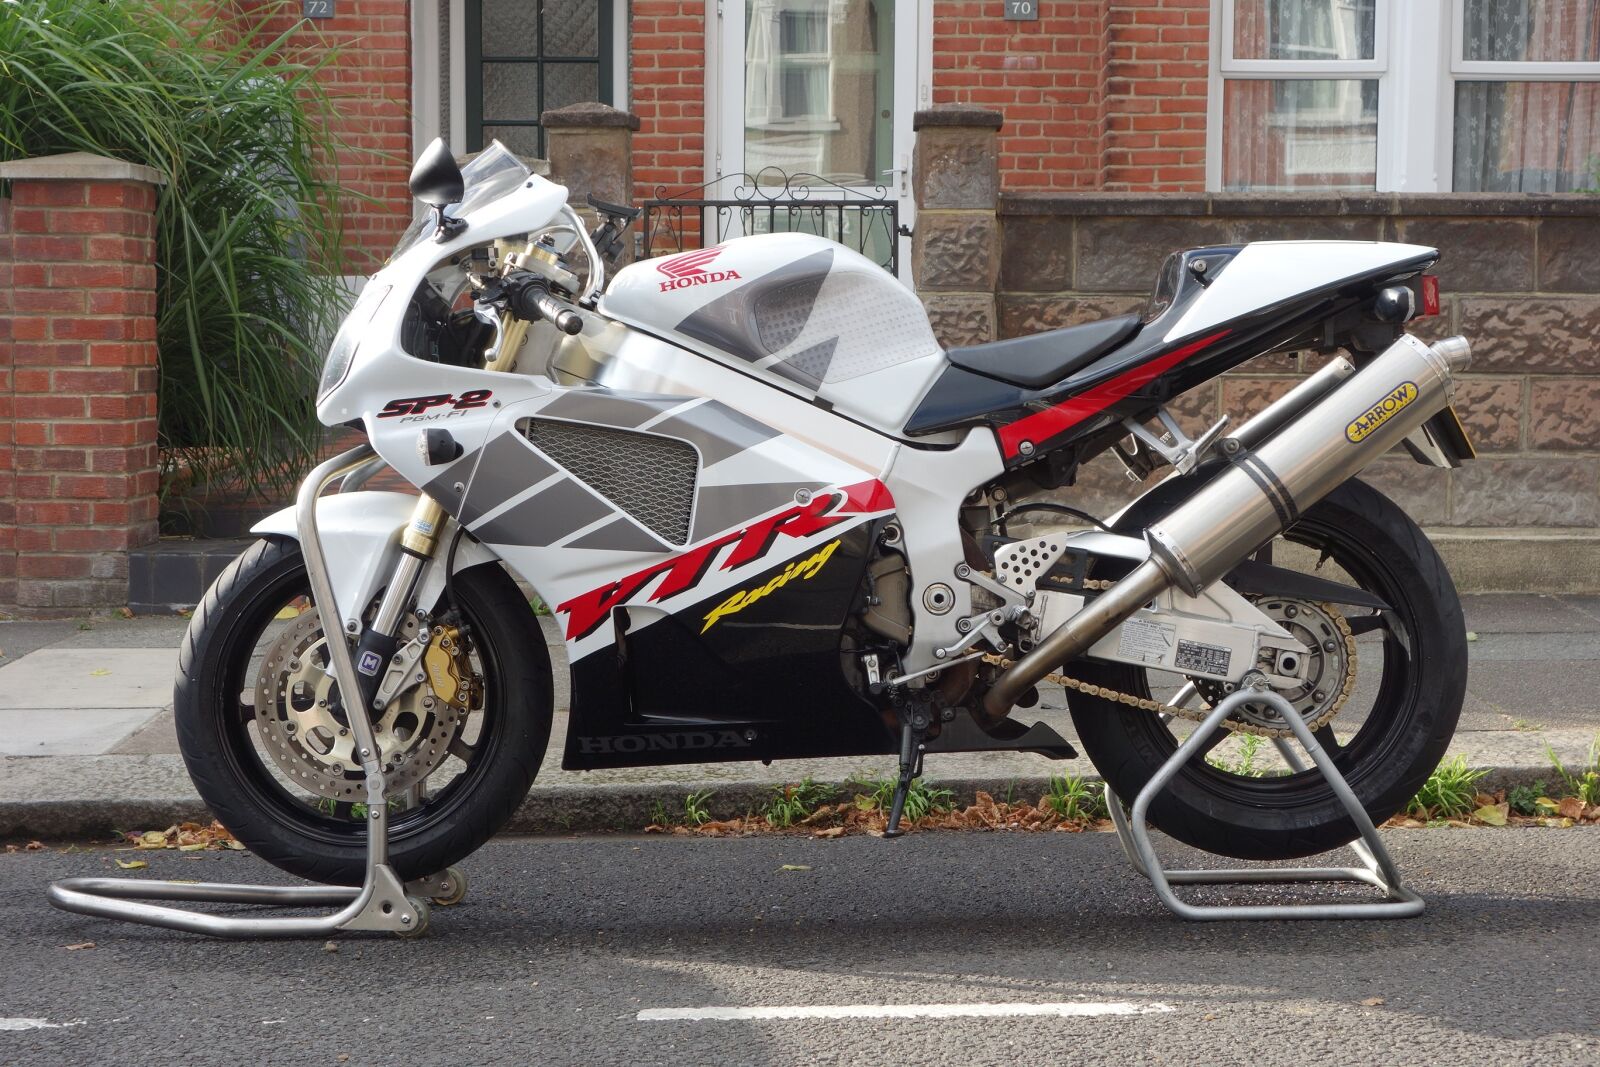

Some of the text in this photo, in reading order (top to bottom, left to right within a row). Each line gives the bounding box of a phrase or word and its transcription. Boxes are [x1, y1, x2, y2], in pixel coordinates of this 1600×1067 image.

[308, 1, 327, 13] 72
[1012, 2, 1031, 14] 70
[659, 270, 742, 292] HONDA
[376, 389, 493, 418] SP-2
[1355, 385, 1408, 435] ARROW
[555, 493, 856, 642] VTR
[700, 539, 841, 635] Racing
[577, 731, 751, 754] HONDA
